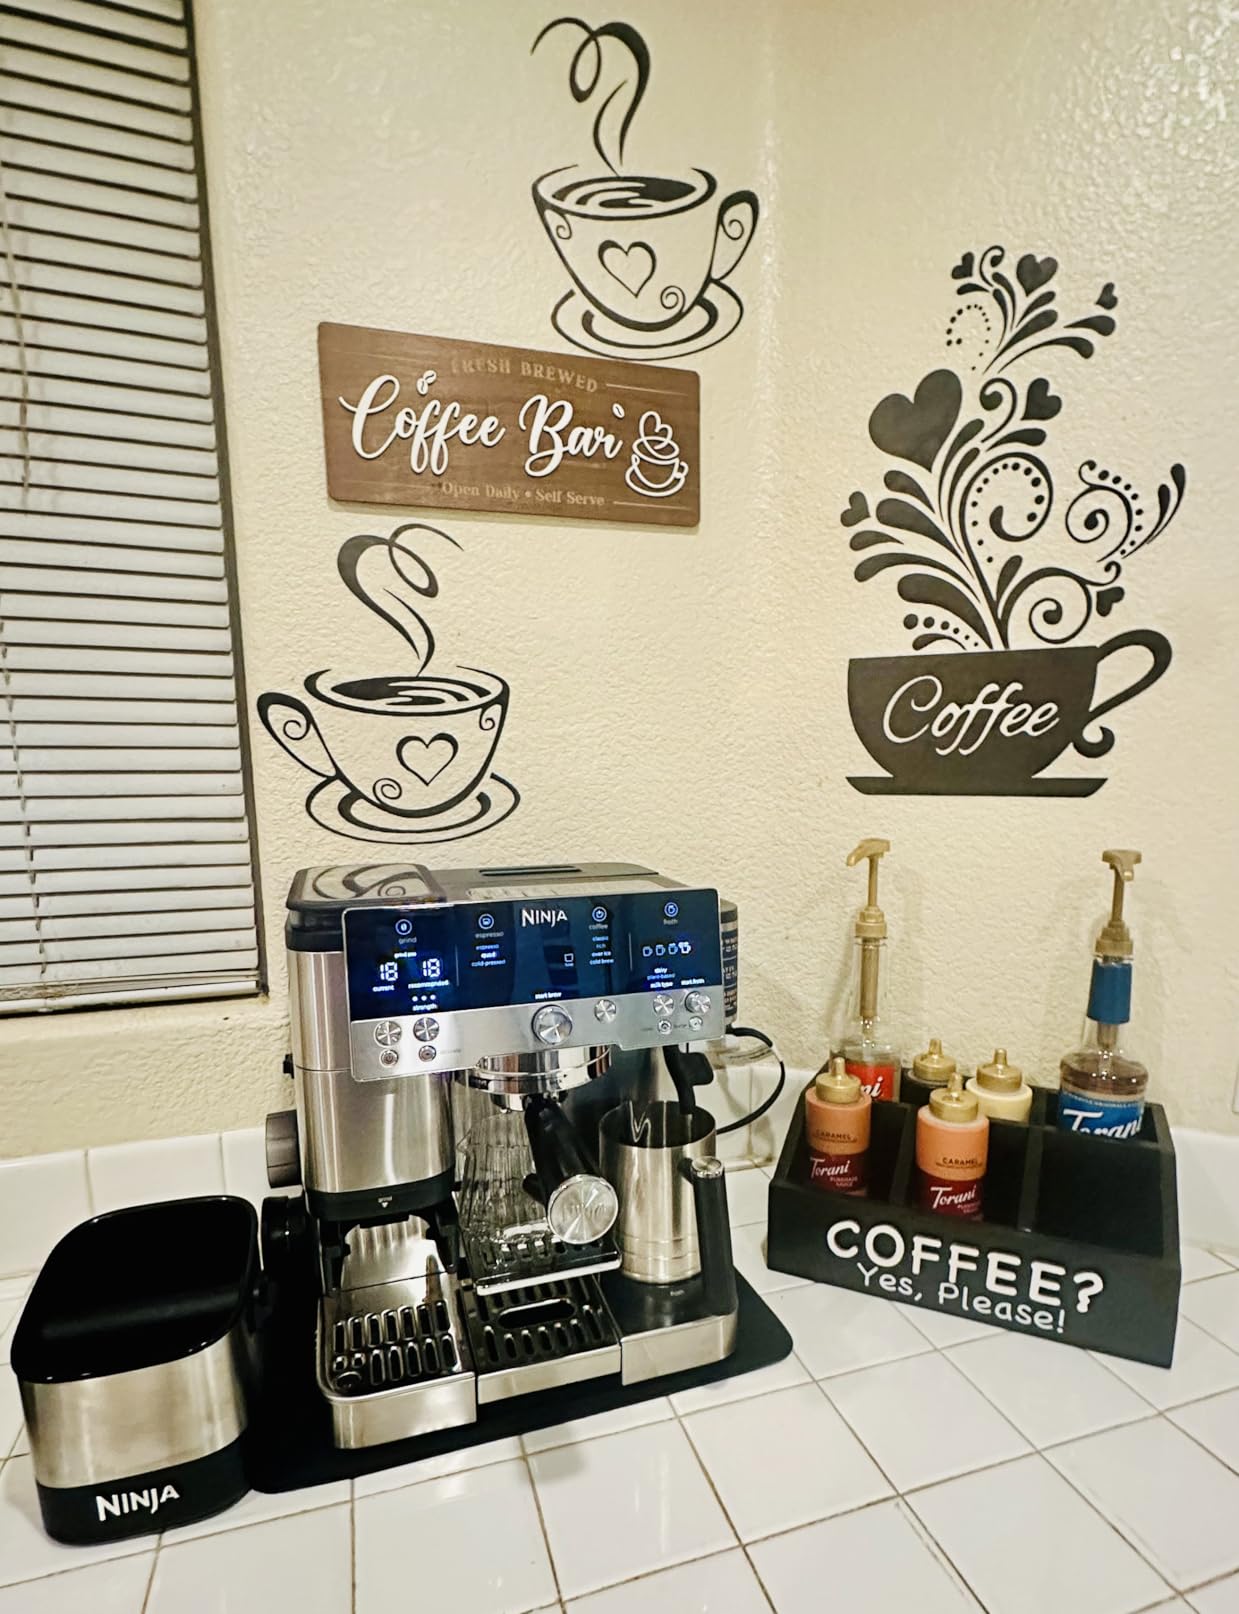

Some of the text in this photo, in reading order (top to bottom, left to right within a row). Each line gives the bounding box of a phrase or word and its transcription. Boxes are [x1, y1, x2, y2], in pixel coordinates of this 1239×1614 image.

[449, 358, 598, 392] FRESH BREWED
[339, 374, 623, 477] Coffee Bar
[441, 481, 605, 506] Open Daily Self Serve
[883, 674, 1060, 756] Coffee
[521, 908, 569, 928] NINJA
[379, 957, 441, 982] 18 18
[809, 1156, 850, 1179] Torani
[942, 1156, 978, 1166] CARAMEL
[930, 1183, 977, 1209] Torani
[826, 1219, 1104, 1314] COFFEE?
[856, 1261, 1067, 1334] Yes, Please!
[96, 1484, 180, 1521] NINJA
